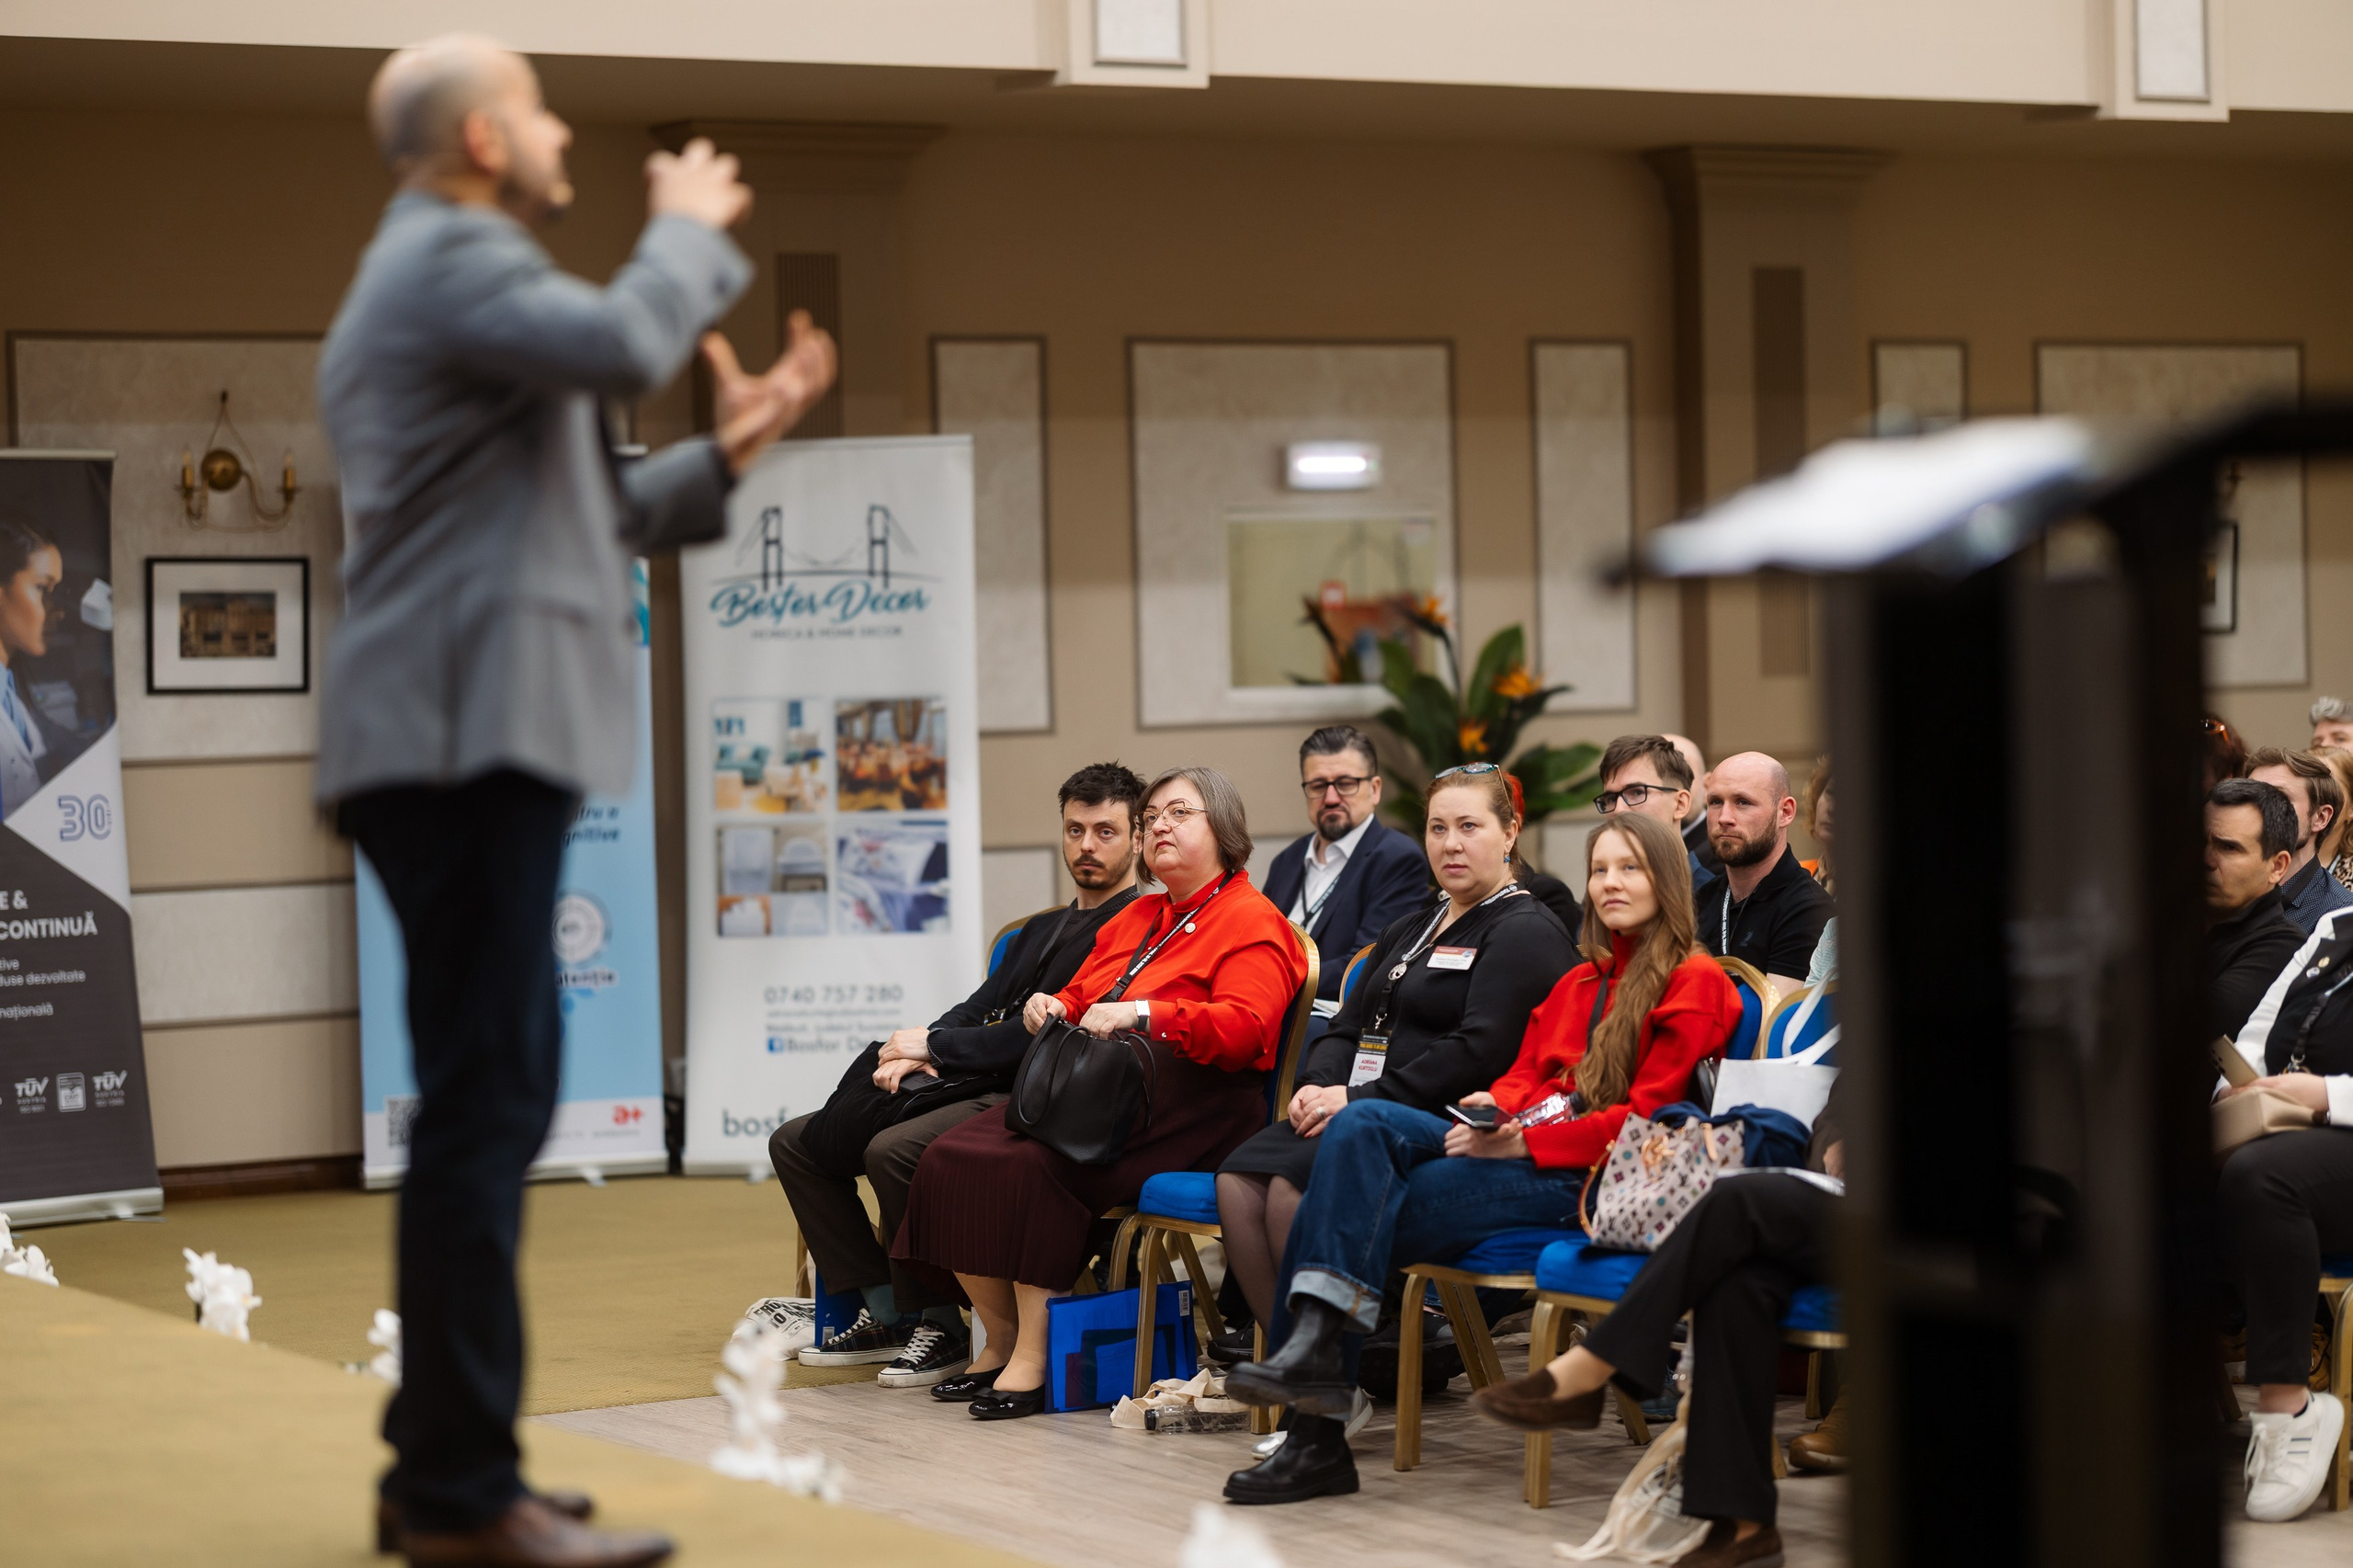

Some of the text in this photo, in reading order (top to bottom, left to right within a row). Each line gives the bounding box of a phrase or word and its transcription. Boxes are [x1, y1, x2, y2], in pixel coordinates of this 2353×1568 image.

[824, 578, 931, 624] Decor
[58, 794, 111, 842] 30
[13, 890, 28, 910] &
[0, 910, 98, 940] CONTINUĂ
[26, 970, 86, 985] dezvoltate
[764, 984, 904, 1004] 0740 757 280
